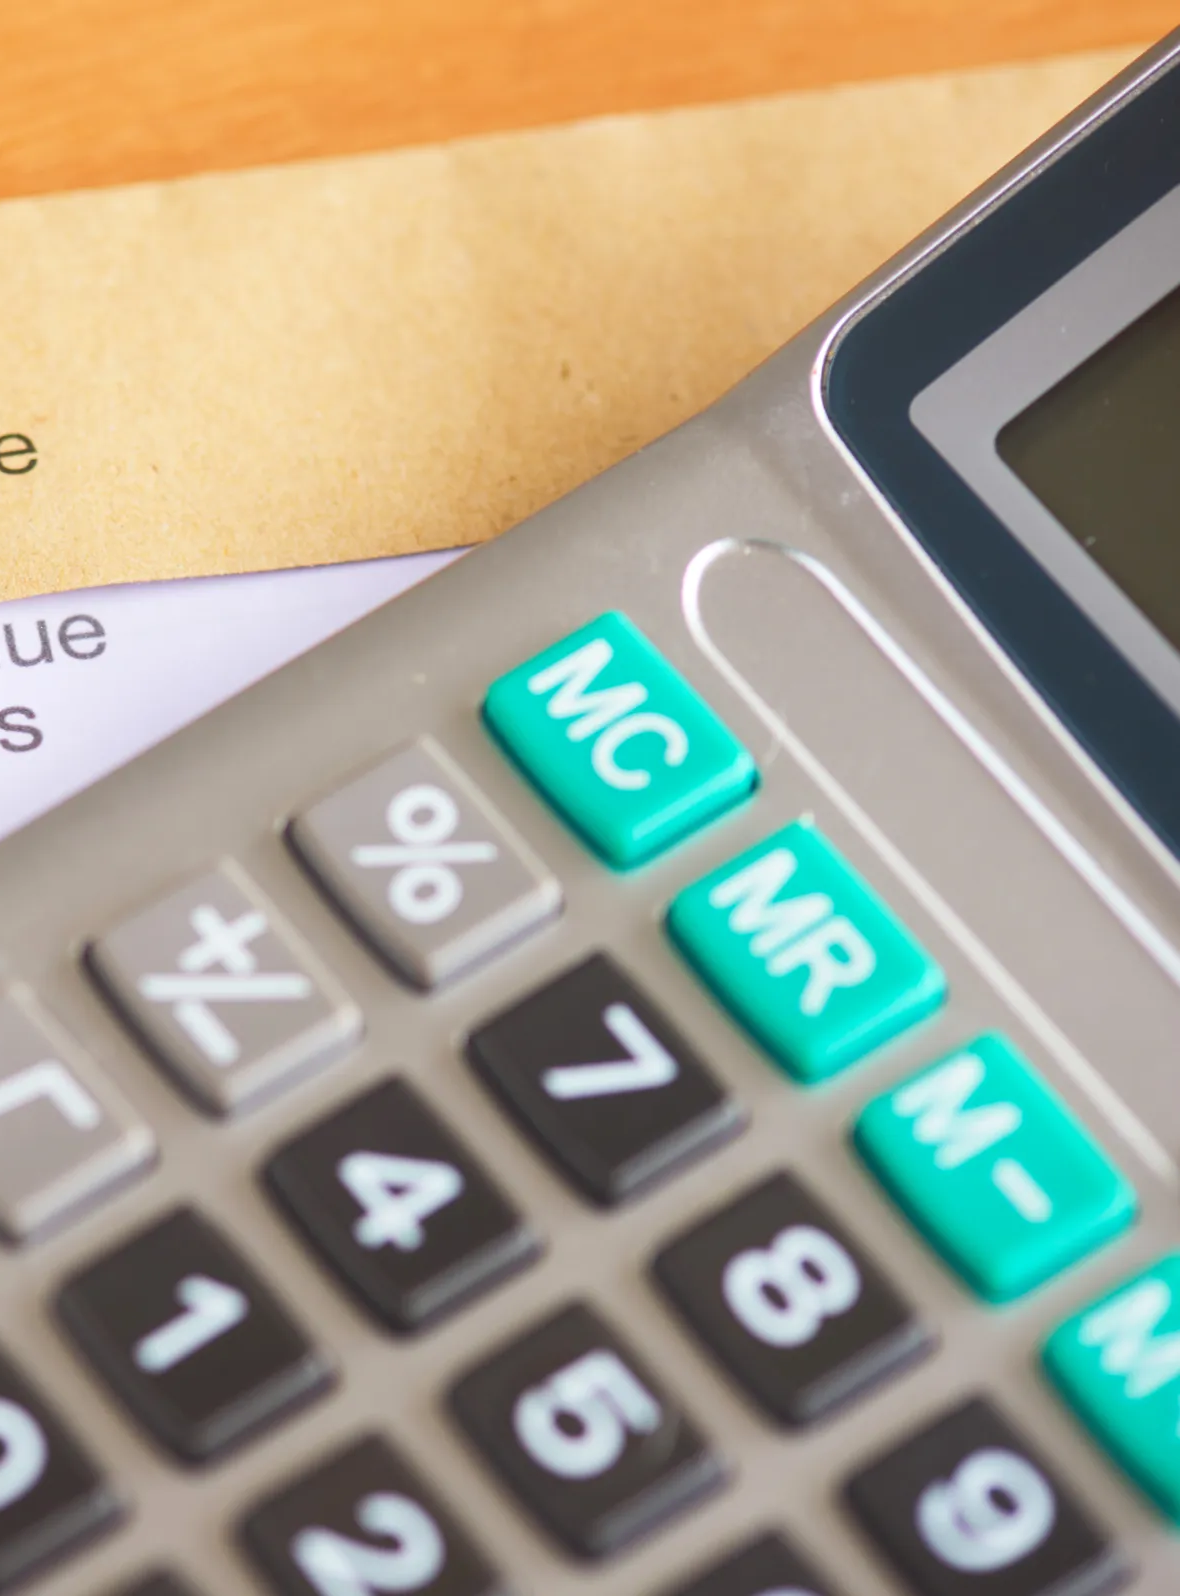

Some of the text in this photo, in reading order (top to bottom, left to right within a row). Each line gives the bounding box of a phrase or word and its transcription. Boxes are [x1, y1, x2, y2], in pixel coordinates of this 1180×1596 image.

[527, 638, 689, 791] MC
[349, 783, 498, 924] %
[709, 849, 877, 1016] MR
[542, 1003, 678, 1100] 7
[338, 1150, 464, 1251] 4
[134, 1273, 247, 1373] 1
[722, 1224, 861, 1348] 8
[513, 1349, 663, 1480] 5
[1077, 1278, 1180, 1440] M
[291, 1491, 445, 1596] 2
[916, 1448, 1056, 1573] 9
